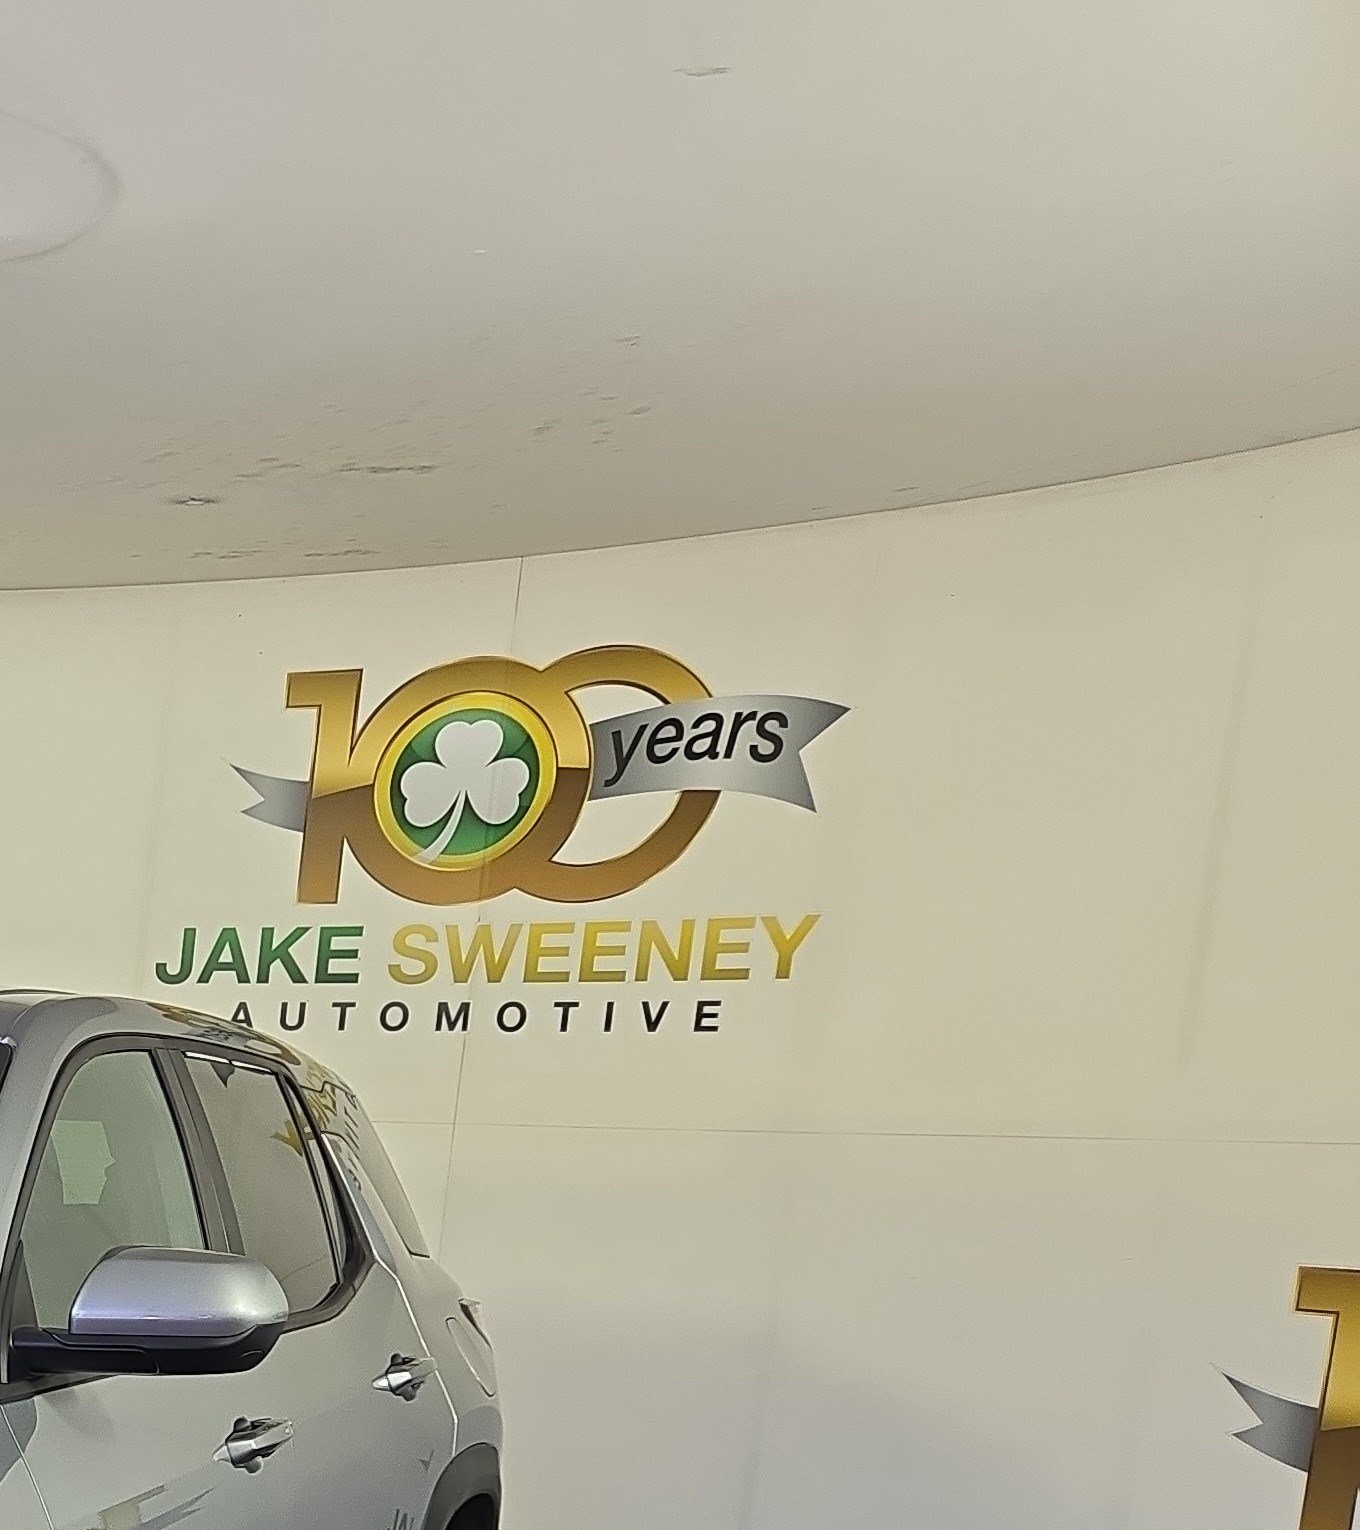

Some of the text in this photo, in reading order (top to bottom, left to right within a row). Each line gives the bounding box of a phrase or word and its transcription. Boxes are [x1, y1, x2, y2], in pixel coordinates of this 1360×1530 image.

[285, 644, 723, 906] 100
[603, 708, 790, 787] years
[154, 913, 822, 986] JAKE SWEENEY
[231, 1000, 723, 1033] AUTOMOTIVE
